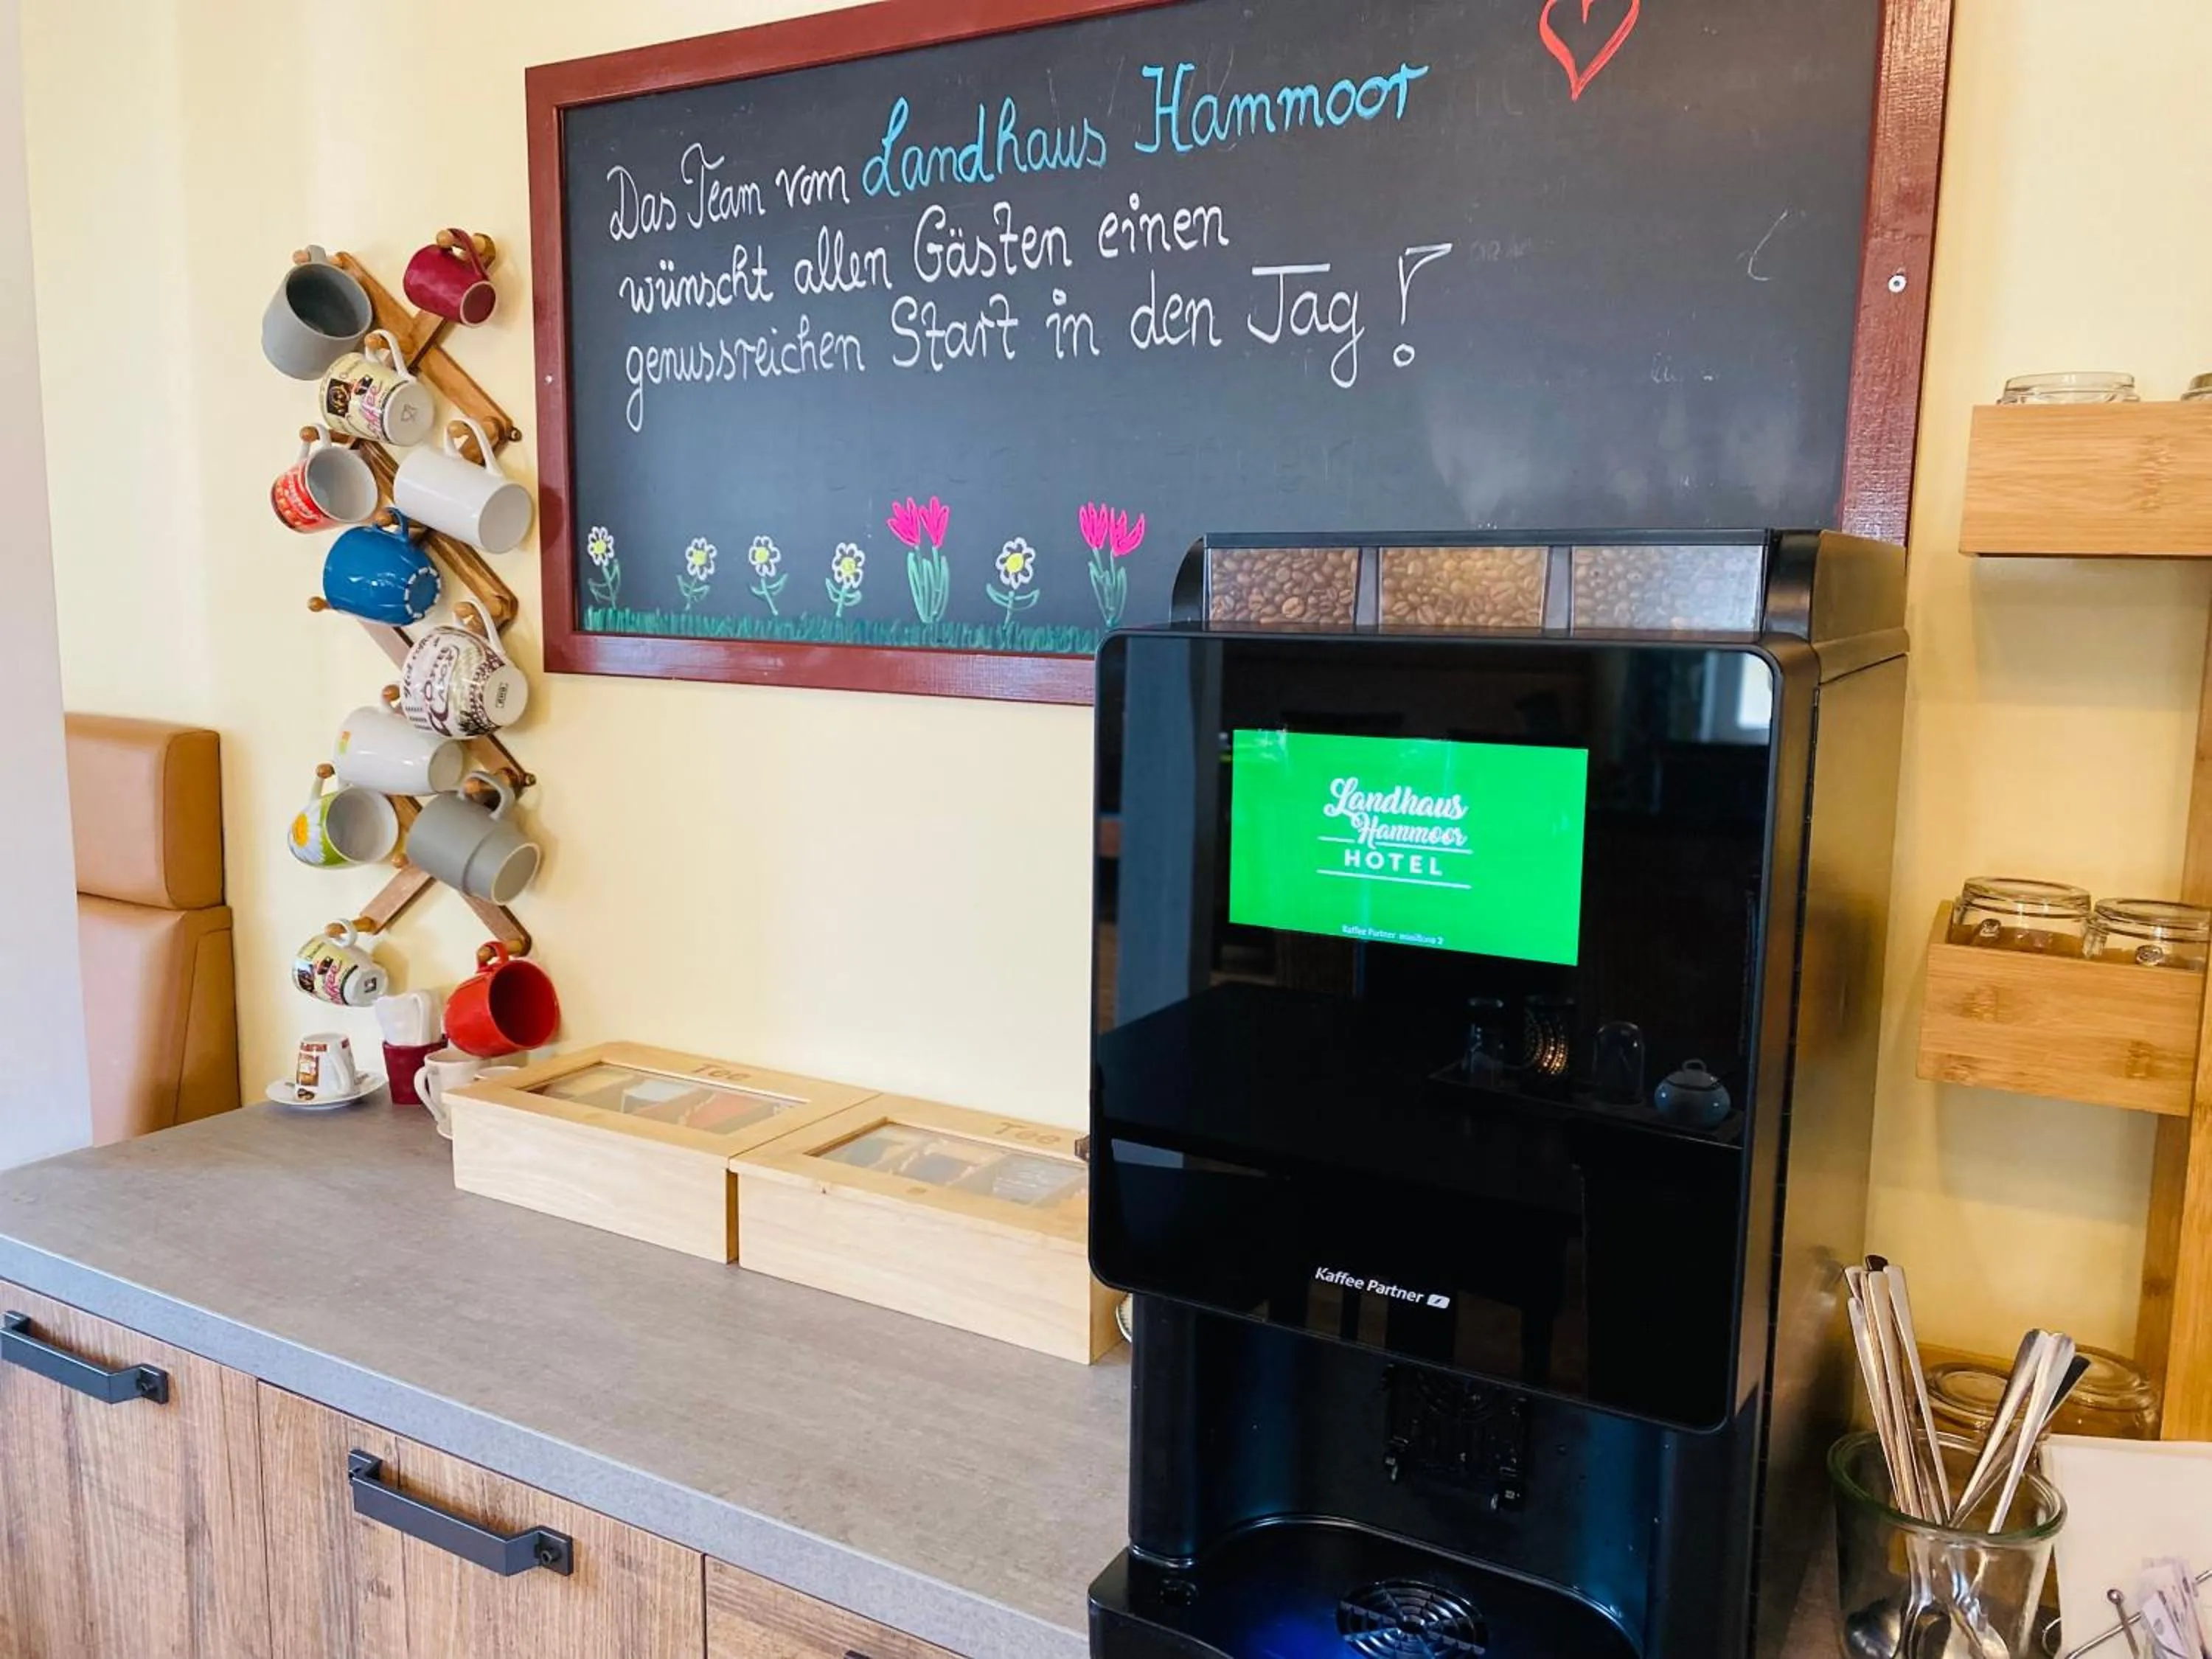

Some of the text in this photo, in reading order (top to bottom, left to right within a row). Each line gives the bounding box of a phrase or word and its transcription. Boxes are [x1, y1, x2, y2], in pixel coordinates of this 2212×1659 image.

[608, 62, 1429, 241] Das Team vom Landhaus Hammoor
[619, 192, 1229, 314] wünscht allen Gästen einen
[625, 314, 866, 433] genussreichen
[891, 293, 1018, 371] Start
[1046, 288, 1100, 359] in
[1130, 269, 1222, 351] den
[1247, 262, 1365, 388] Tag
[1324, 776, 1470, 821] Landhaus
[1351, 812, 1467, 849] Hammoor
[1345, 849, 1443, 876] HOTEL
[691, 1063, 752, 1081] Tee
[993, 1121, 1062, 1145] Tee
[1315, 1267, 1424, 1303] Kaffee Partner
